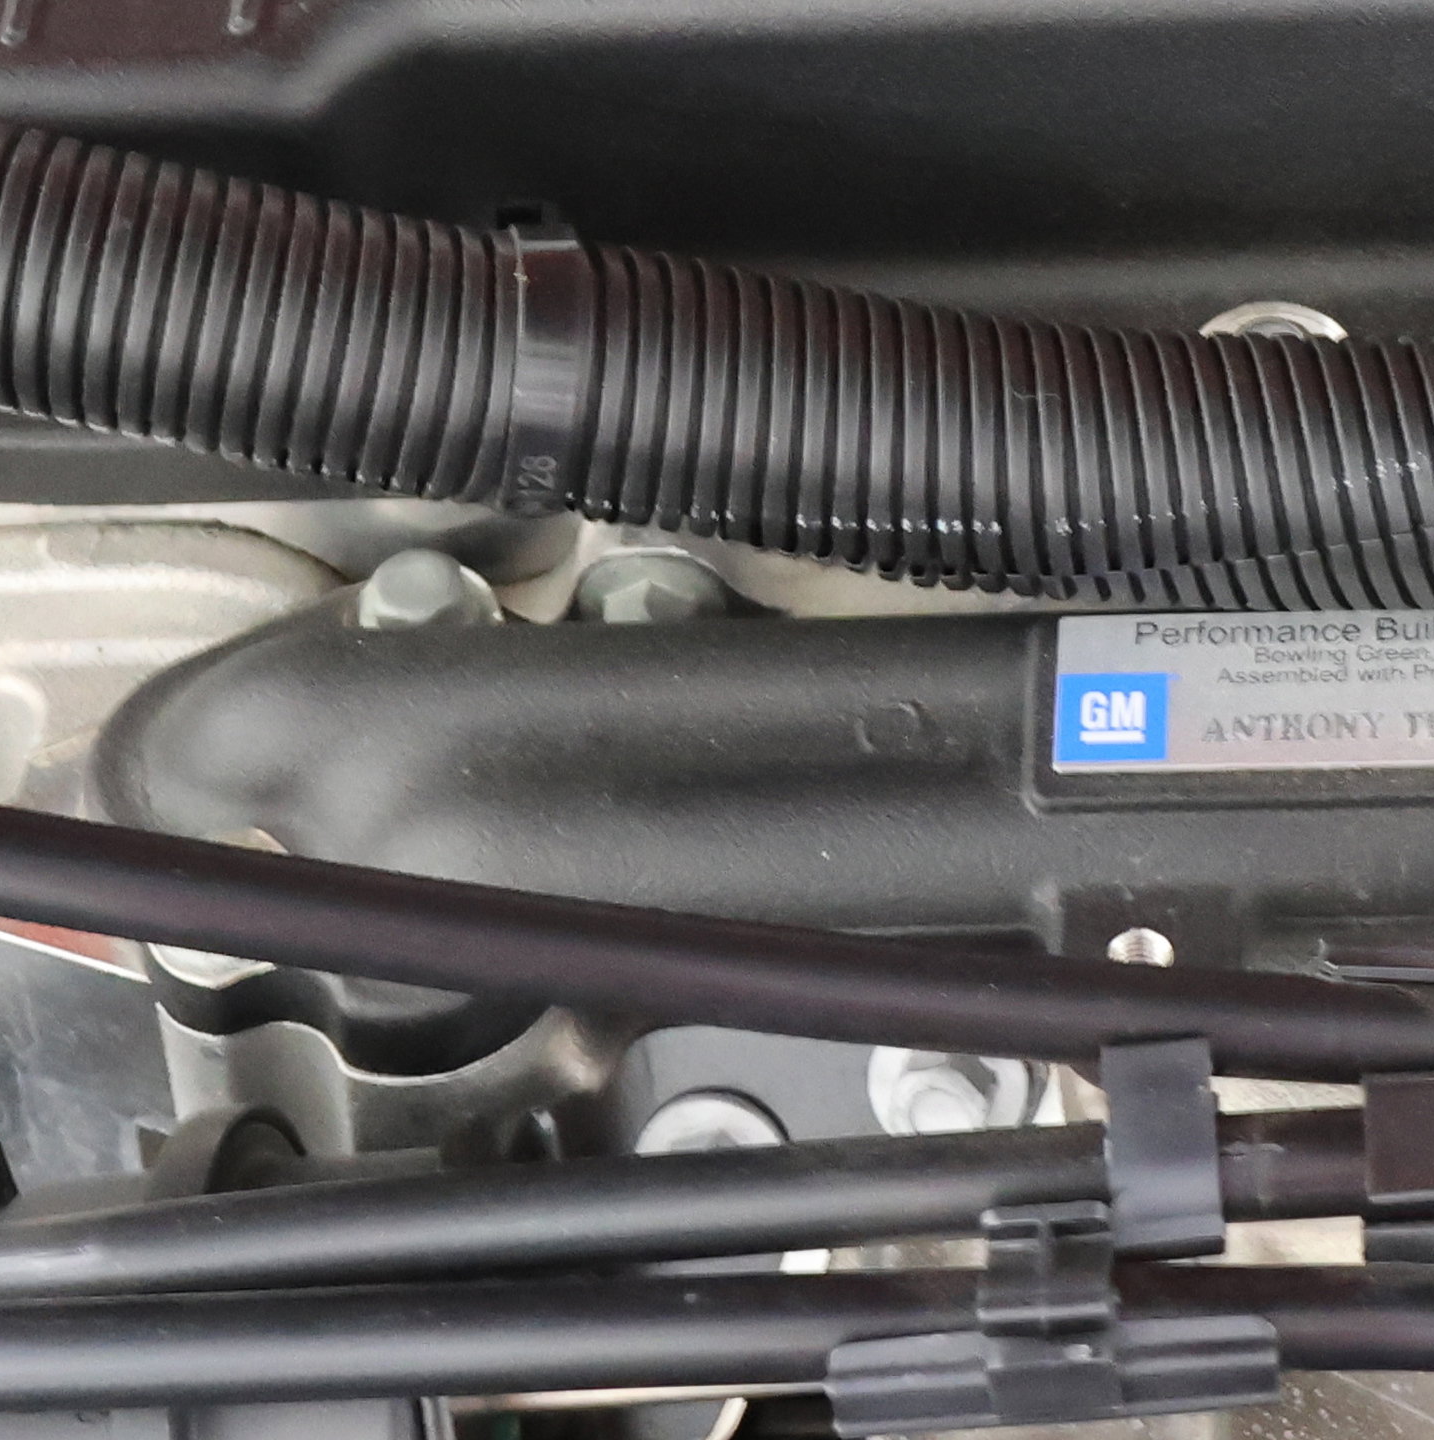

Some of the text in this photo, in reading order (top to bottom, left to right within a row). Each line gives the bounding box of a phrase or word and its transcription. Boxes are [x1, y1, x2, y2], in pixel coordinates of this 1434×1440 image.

[1134, 620, 1362, 646] Performance
[1254, 644, 1347, 665] Bowling
[1217, 667, 1349, 685] Assembled
[1357, 666, 1406, 682] with
[1080, 691, 1147, 730] GM
[1201, 710, 1385, 743] ANTHONY
